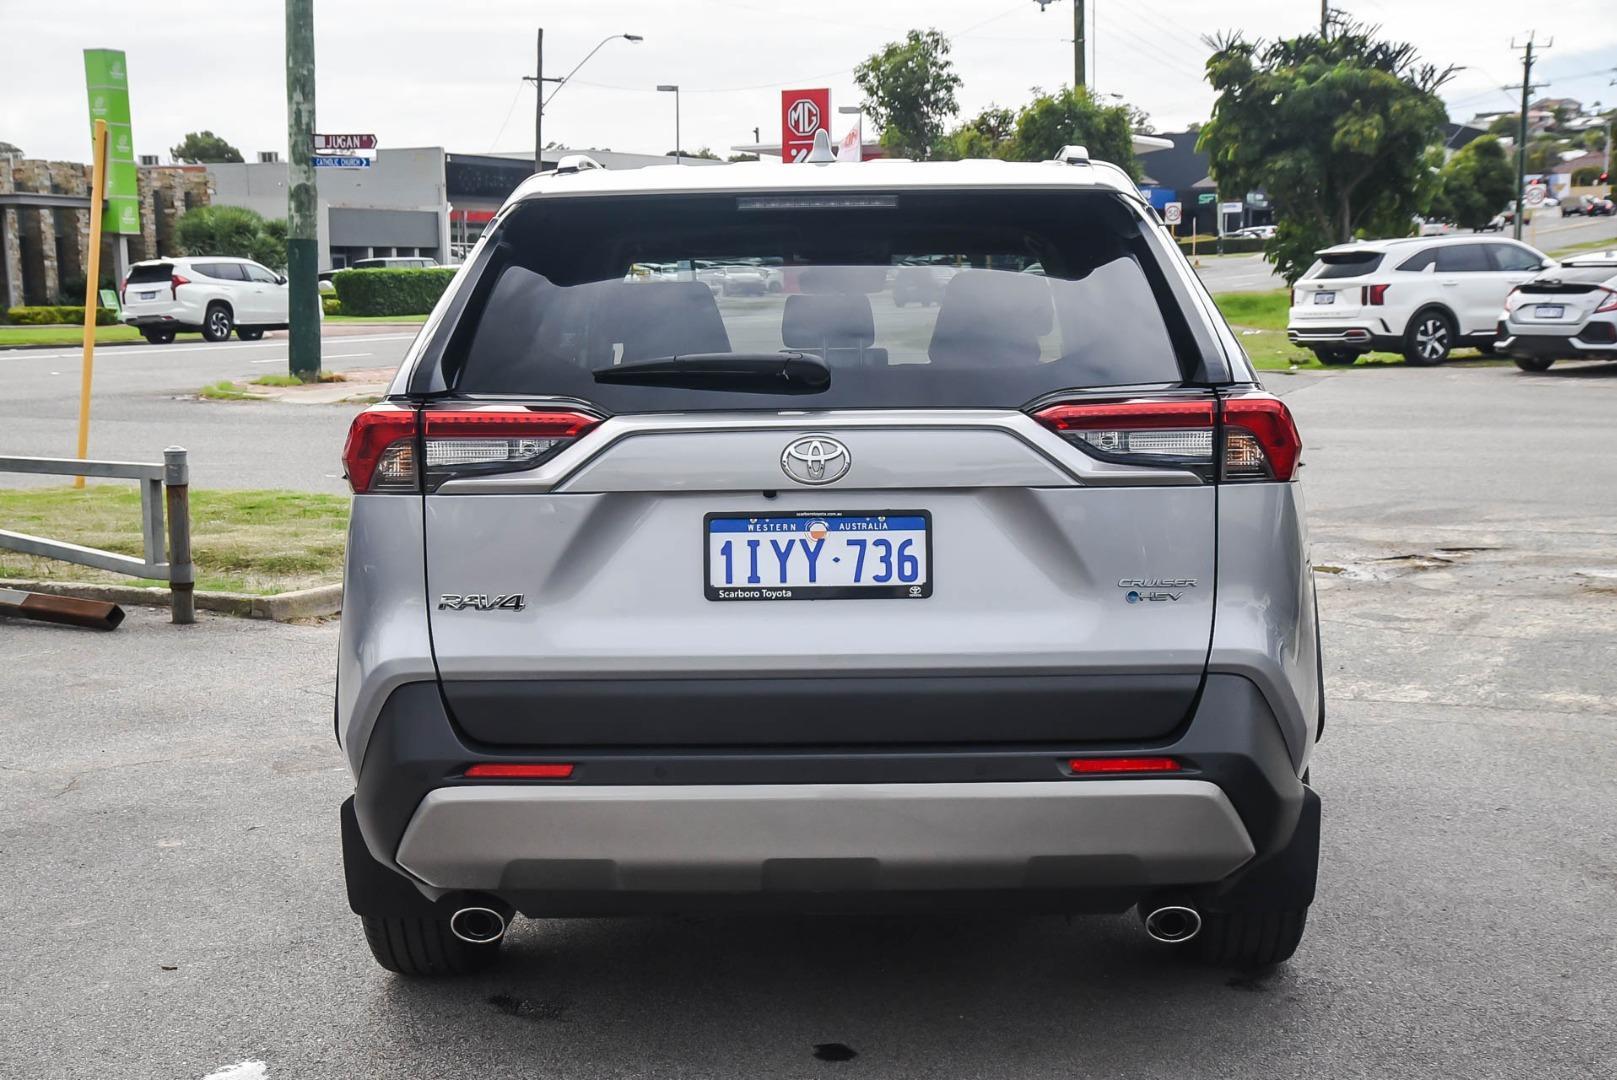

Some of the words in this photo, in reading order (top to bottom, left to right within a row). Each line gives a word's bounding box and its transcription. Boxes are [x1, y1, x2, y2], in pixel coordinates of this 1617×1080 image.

[791, 102, 817, 133] MG
[327, 136, 360, 148] JUGAN
[316, 157, 338, 166] CATHOLIC
[340, 157, 361, 166] CHURCH
[1167, 207, 1179, 218] 50
[747, 524, 797, 532] WESTERN
[839, 522, 888, 531] AUSTRALIA
[1118, 578, 1198, 588] CRUISER
[719, 589, 760, 598] Scarboro
[762, 589, 792, 598] Toyota
[1139, 592, 1184, 601] HEV
[438, 593, 526, 612] RAV4
